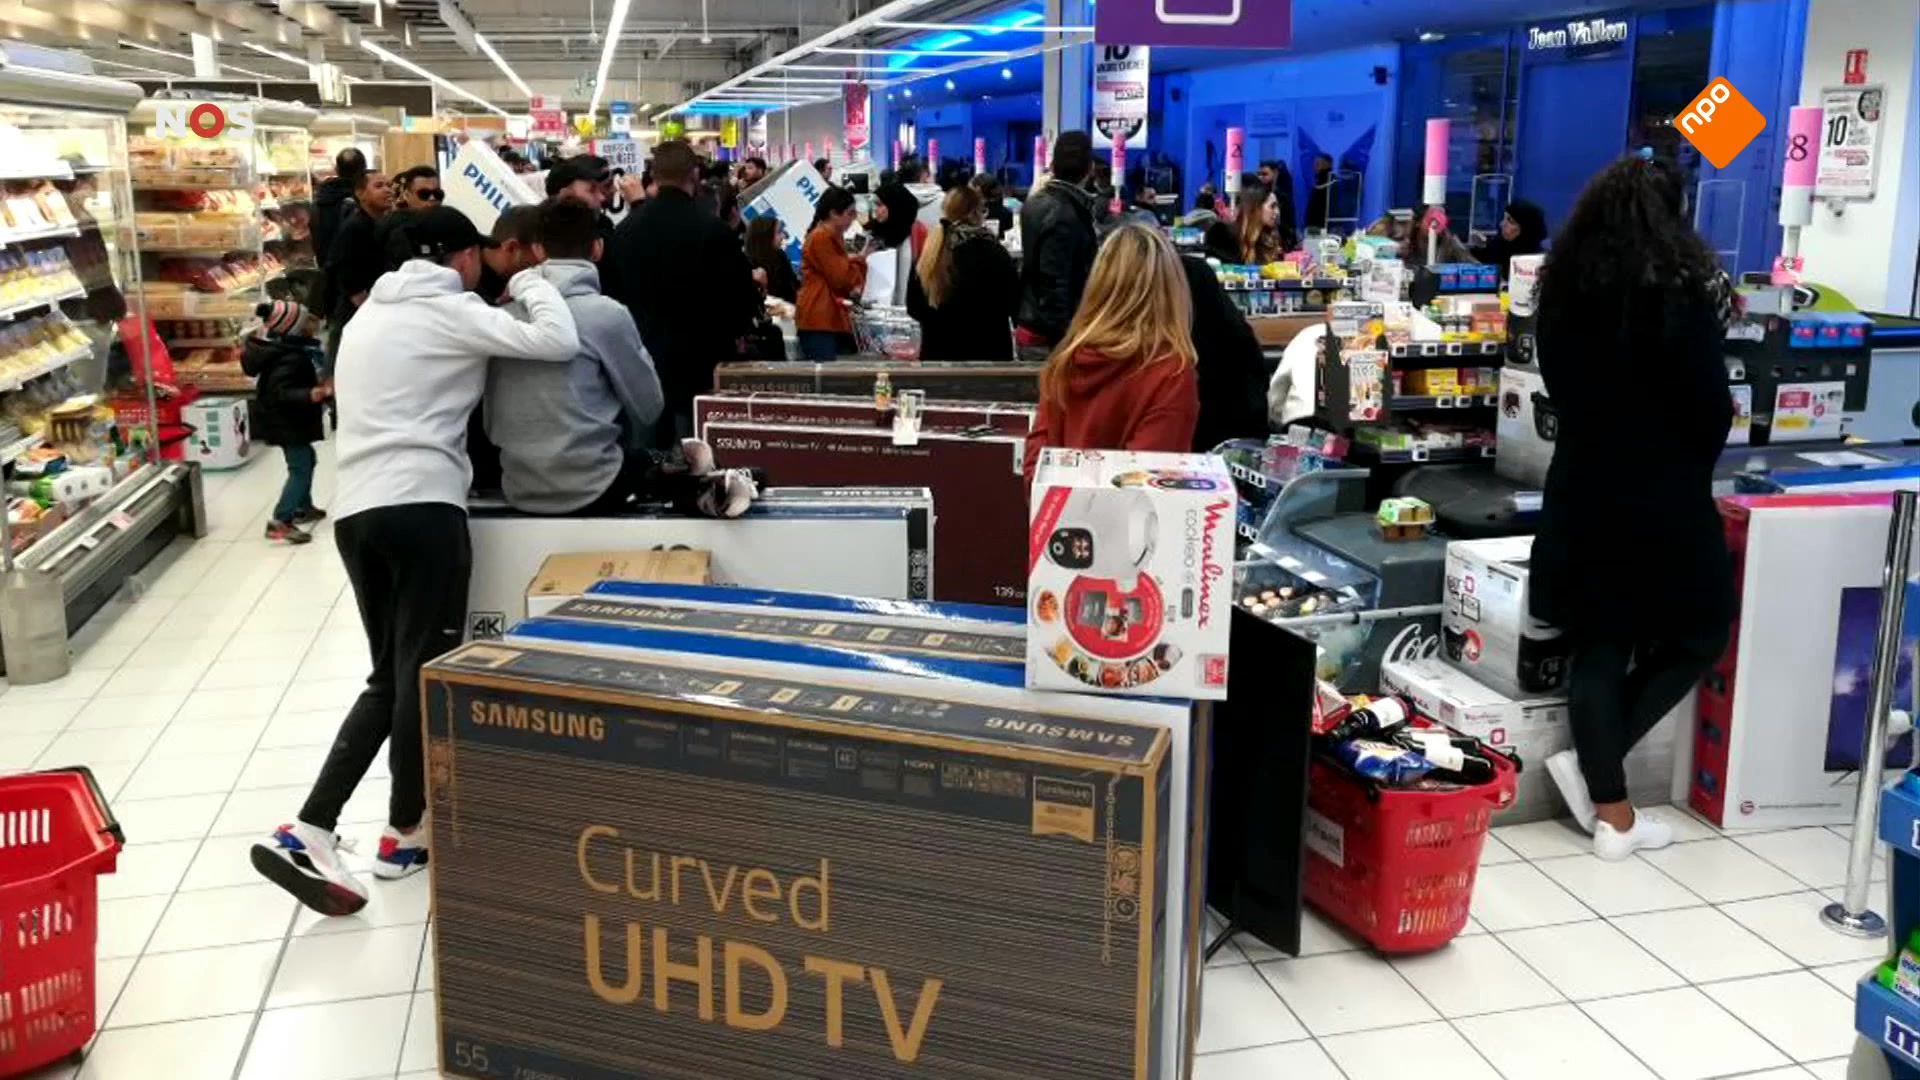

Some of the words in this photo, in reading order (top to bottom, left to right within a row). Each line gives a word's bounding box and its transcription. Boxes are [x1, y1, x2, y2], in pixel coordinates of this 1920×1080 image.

[1827, 115, 1848, 147] 10
[796, 176, 820, 208] PH
[1198, 499, 1231, 630] Moulinex
[473, 616, 502, 637] 4K
[568, 602, 686, 621] SAMSUNG
[471, 700, 606, 742] SAMSUNG
[985, 717, 1137, 747] SAMSUNG
[577, 824, 830, 933] Curved
[583, 913, 789, 1030] UHD
[803, 954, 944, 1063] TV
[454, 1040, 489, 1072] 55
